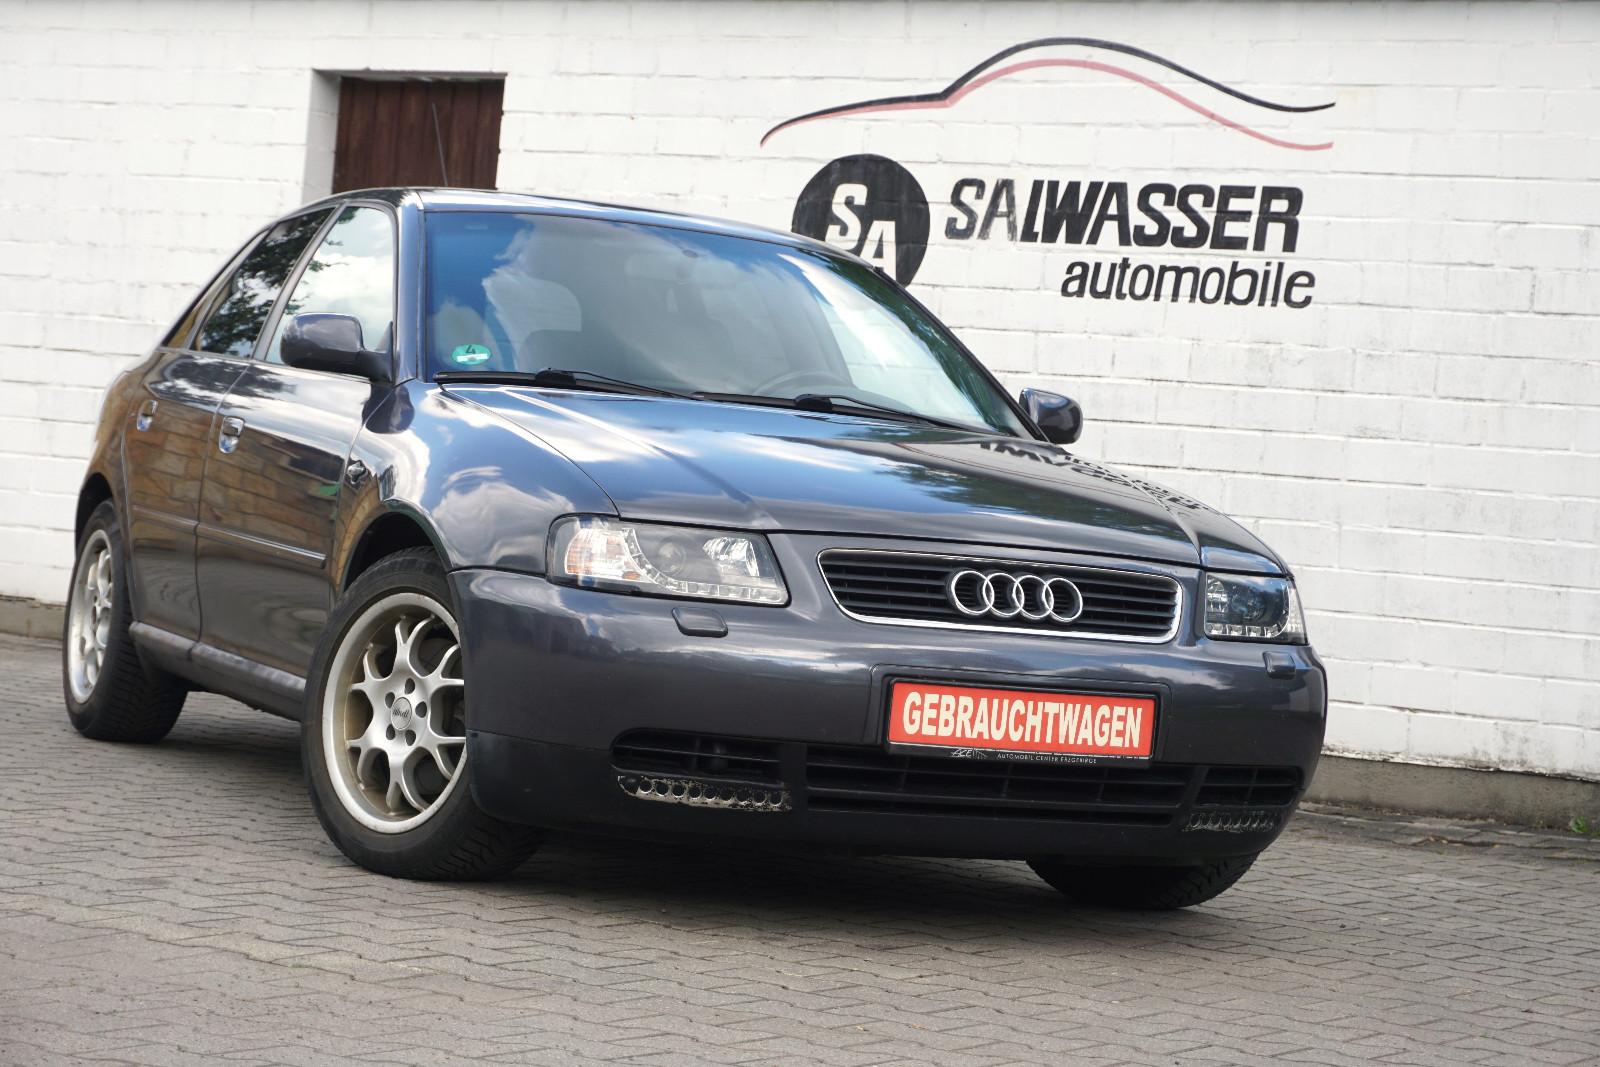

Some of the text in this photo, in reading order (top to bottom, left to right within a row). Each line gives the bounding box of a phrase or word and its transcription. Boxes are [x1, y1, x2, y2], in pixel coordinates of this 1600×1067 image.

[825, 183, 897, 280] SA
[945, 177, 1304, 253] SALWASSER
[1060, 257, 1316, 309] automobile
[465, 344, 476, 355] 4
[903, 691, 1143, 748] GEBRAUCHTWAGEN
[997, 753, 1034, 761] AUTOMOBIL
[1036, 755, 1058, 763] CENTER
